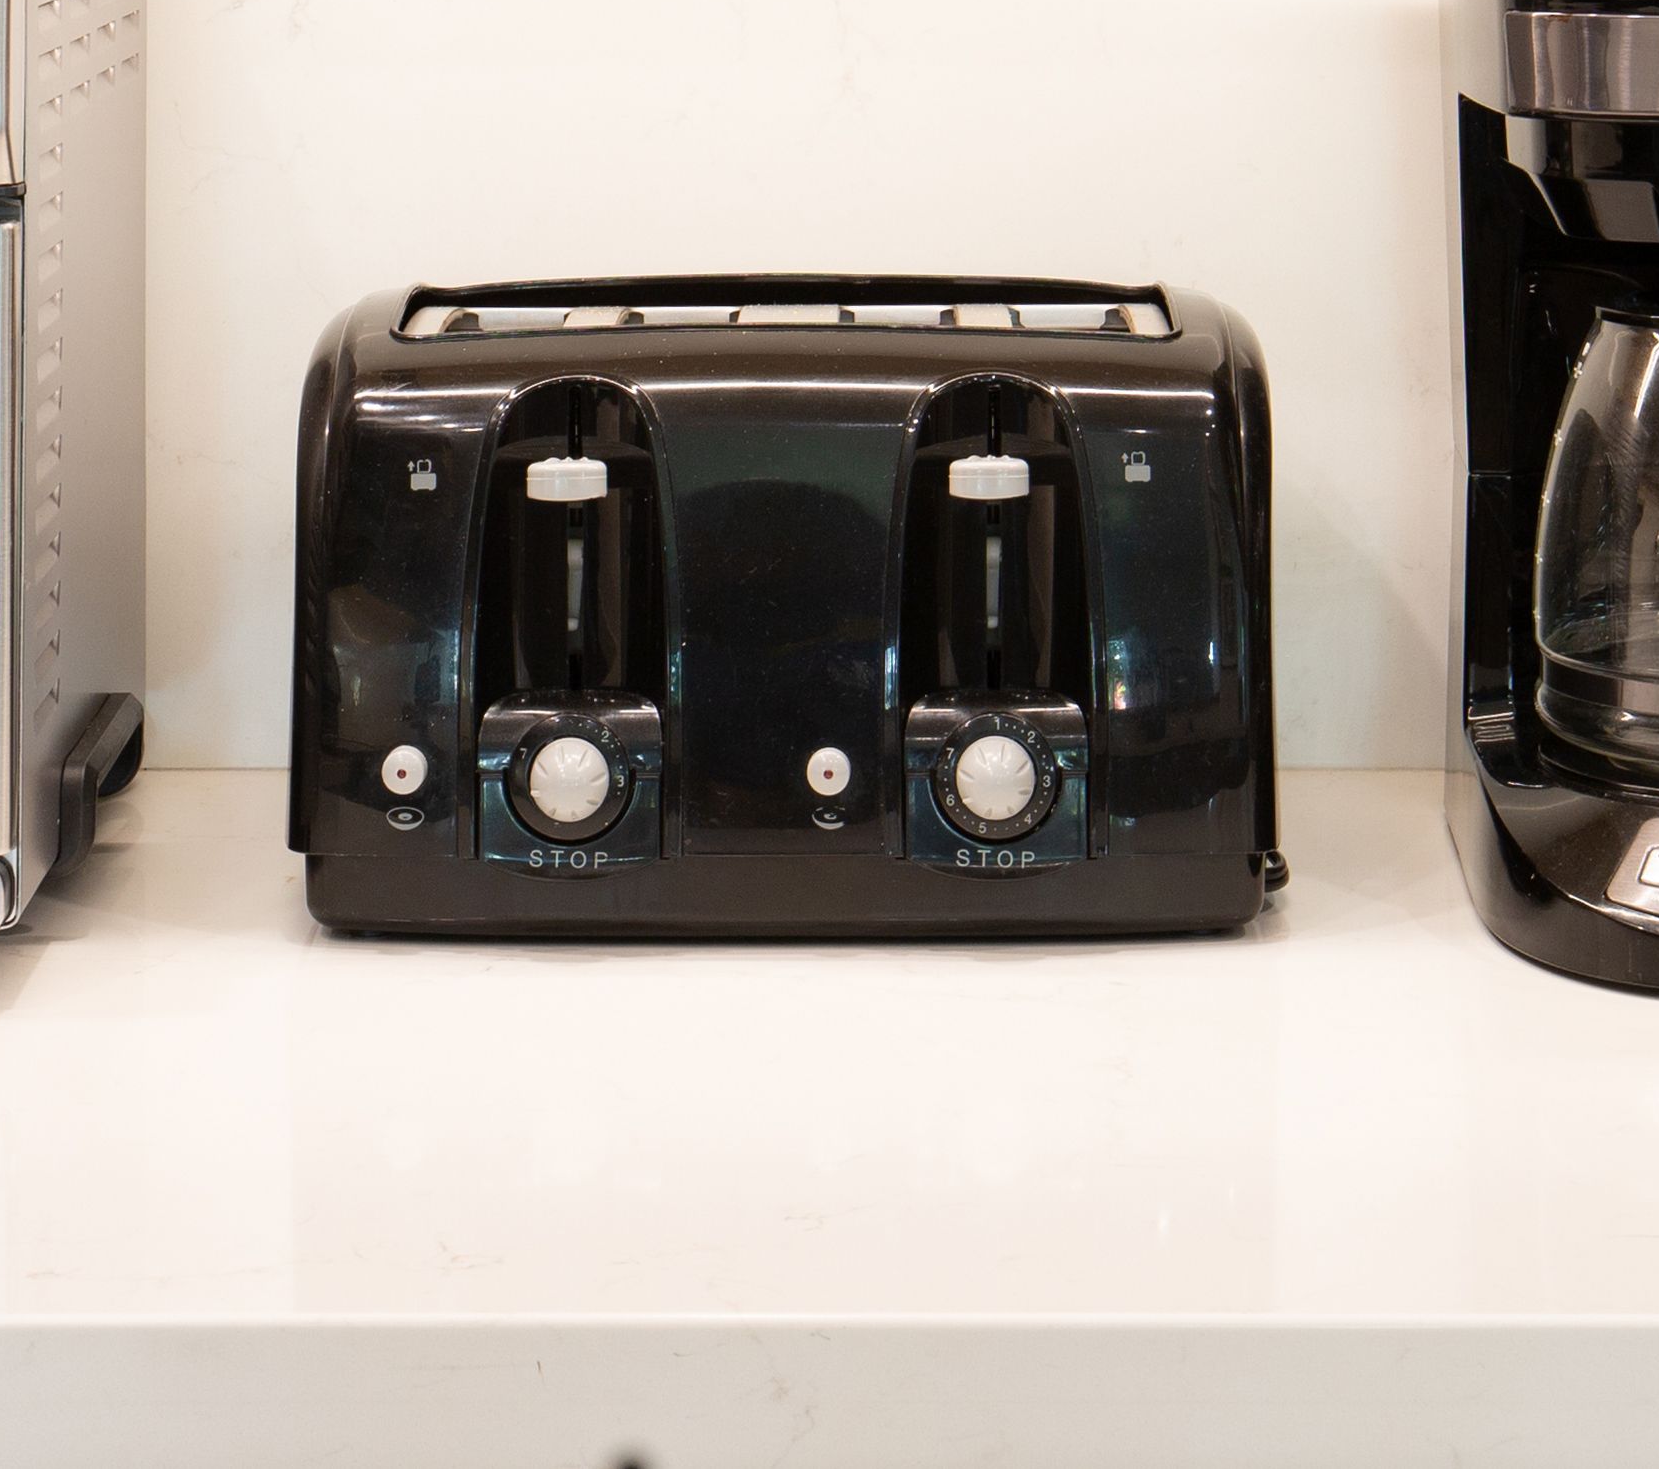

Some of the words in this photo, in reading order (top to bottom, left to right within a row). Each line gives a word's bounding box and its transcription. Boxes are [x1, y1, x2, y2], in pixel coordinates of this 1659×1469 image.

[994, 718, 1001, 730] 1
[601, 731, 609, 743] 2
[1027, 731, 1036, 743] 2
[519, 747, 528, 759] 7
[946, 748, 955, 760] 7
[617, 775, 625, 787] 3
[1043, 775, 1051, 788] 3
[946, 794, 955, 806] 6
[1024, 814, 1032, 825] 4
[978, 822, 987, 834] 5
[529, 849, 608, 869] STOP
[956, 849, 1035, 869] STOP
